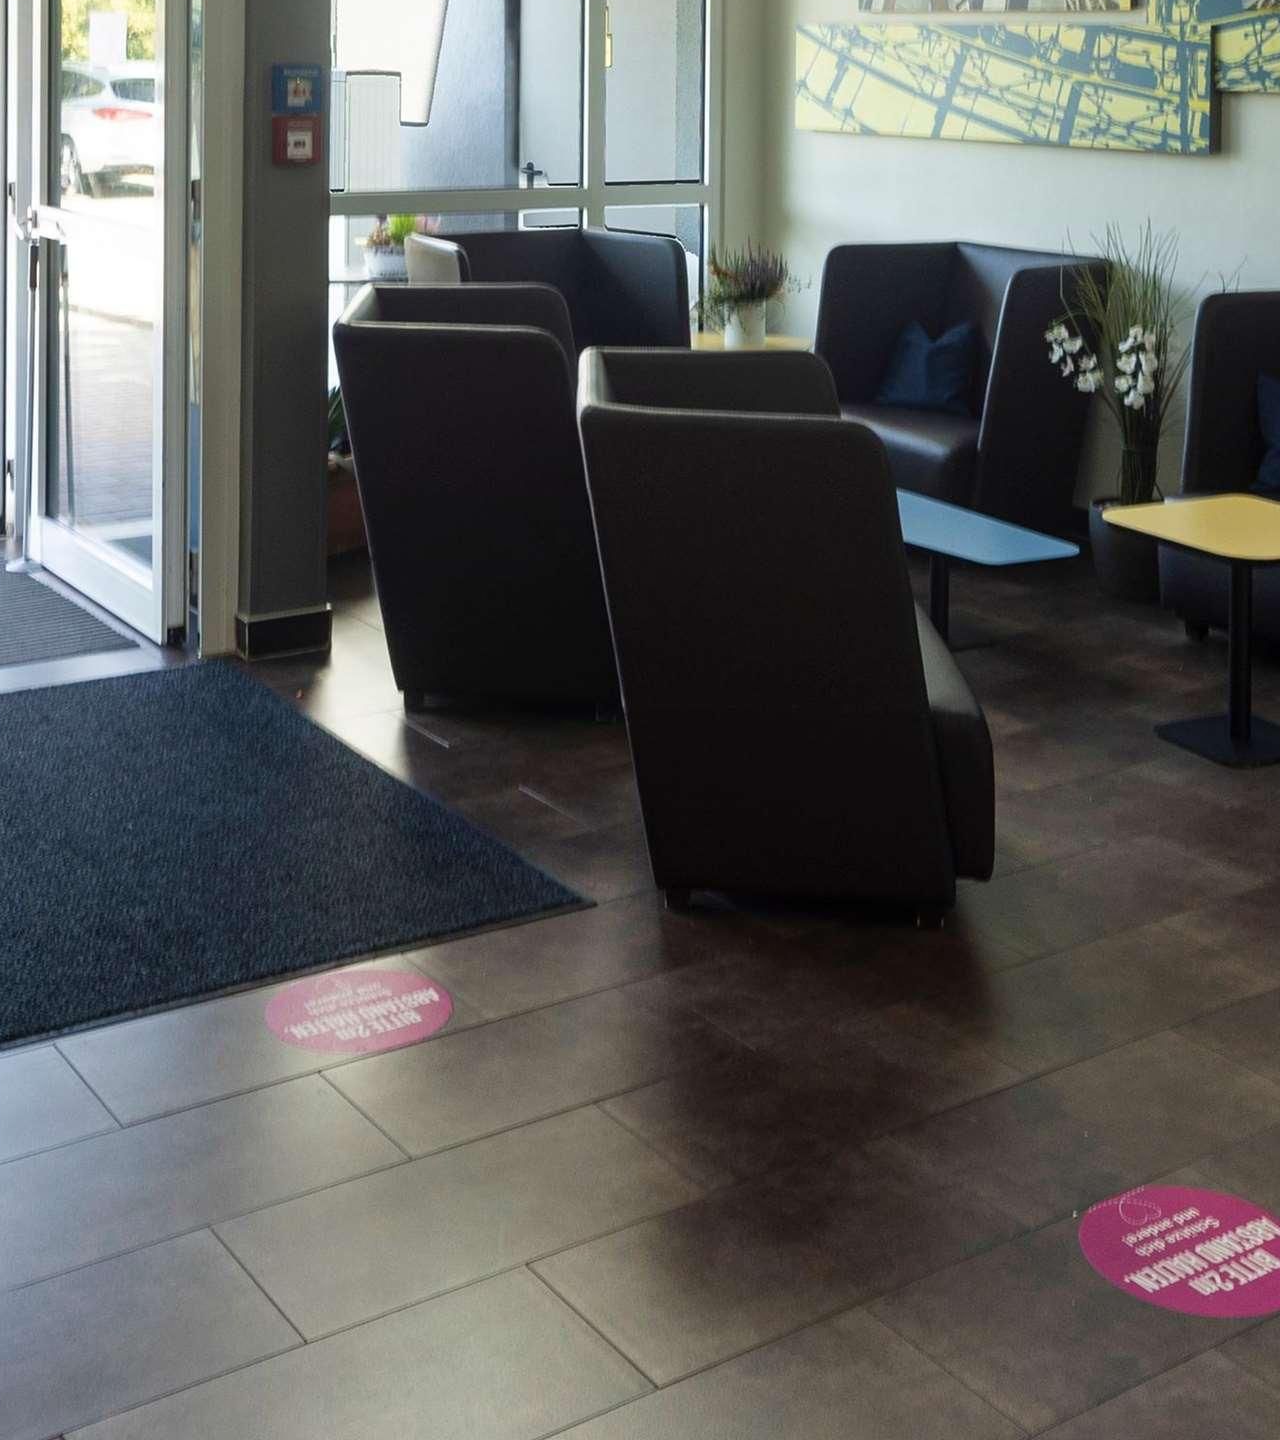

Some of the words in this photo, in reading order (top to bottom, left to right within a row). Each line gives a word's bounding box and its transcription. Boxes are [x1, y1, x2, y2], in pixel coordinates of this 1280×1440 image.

[374, 1010, 422, 1034] BITTE
[1174, 1206, 1200, 1224] und
[1135, 1239, 1167, 1257] dich
[1188, 1270, 1234, 1295] 2m
